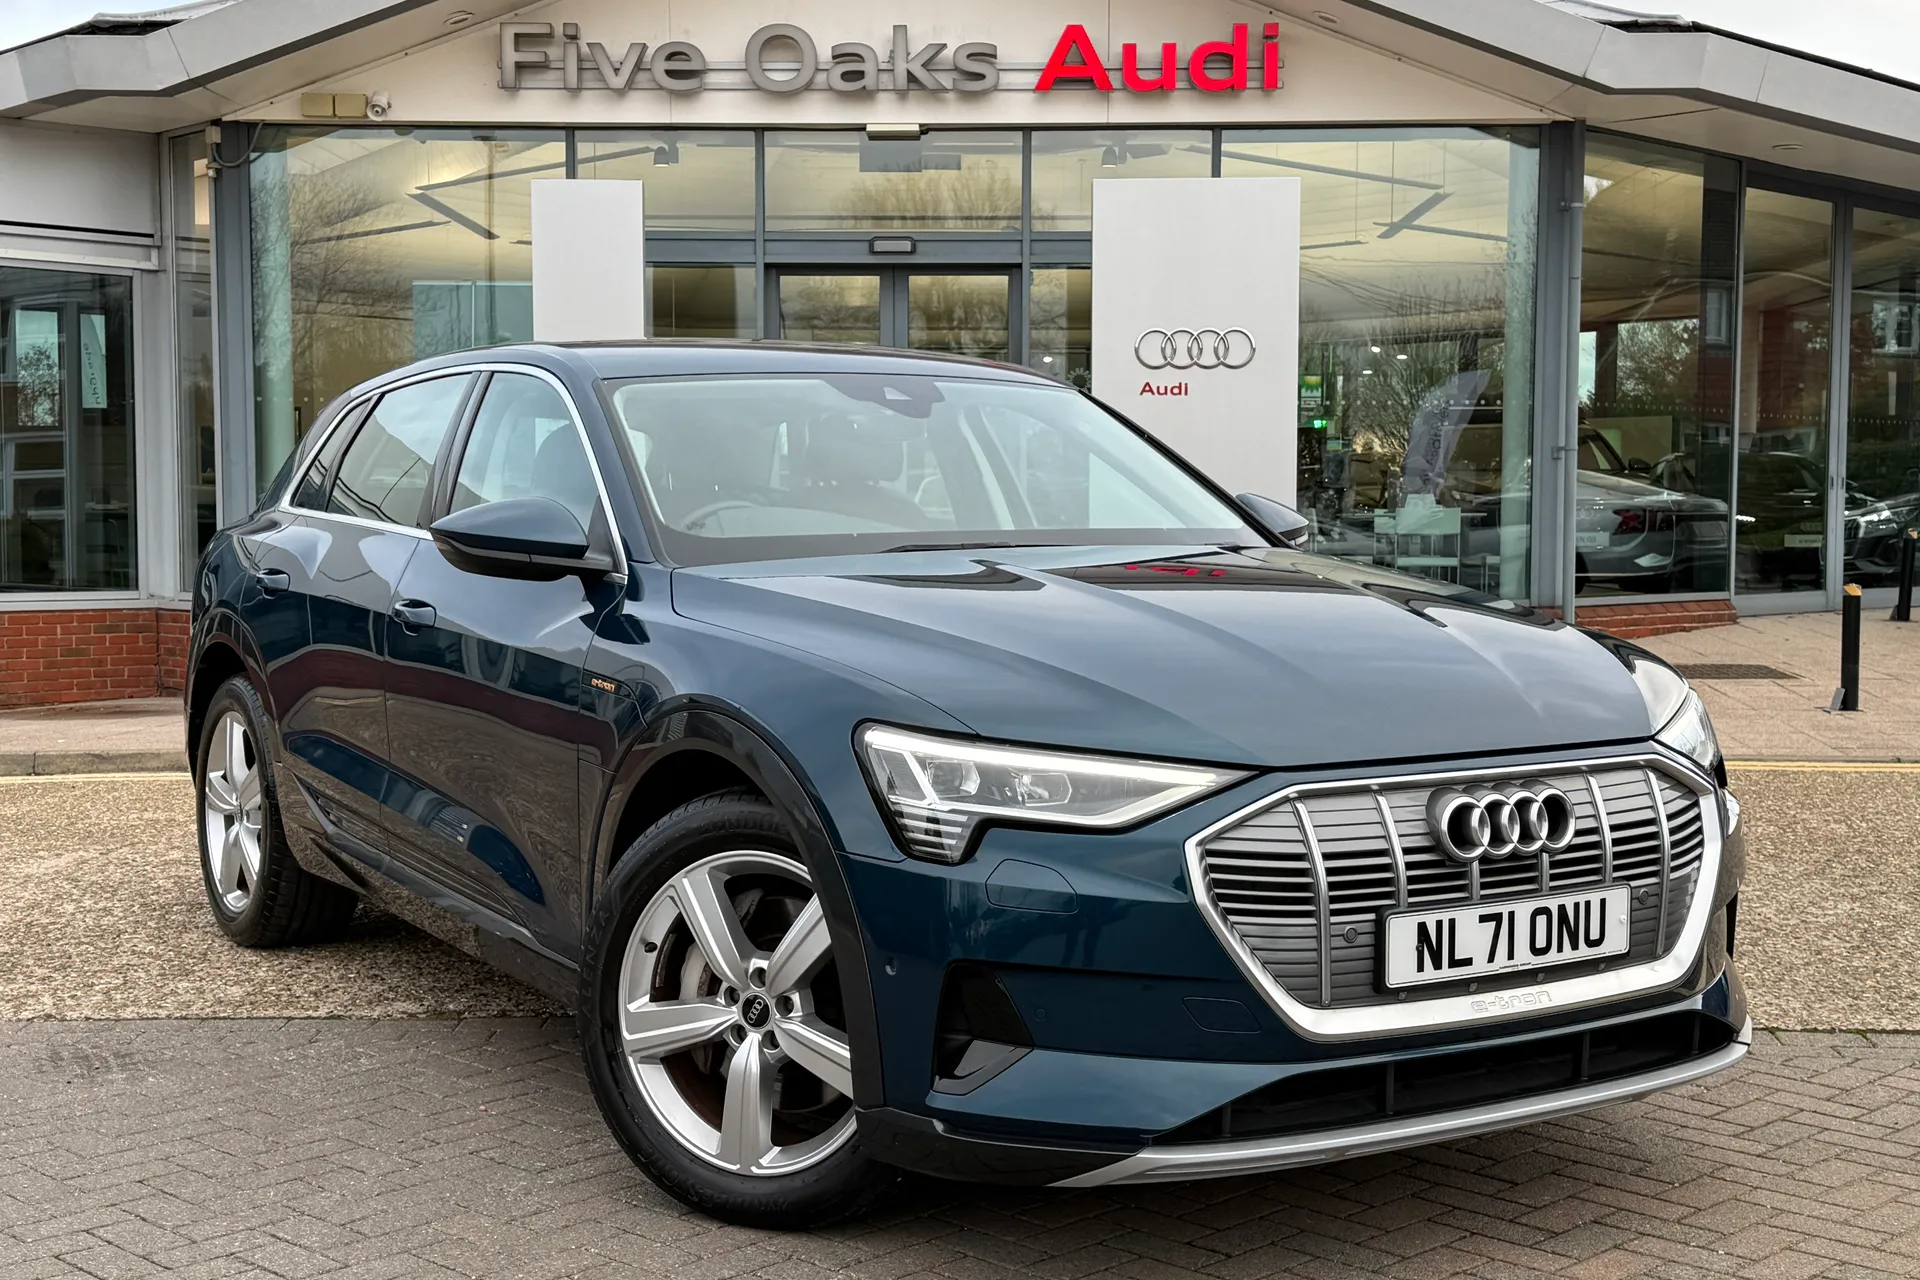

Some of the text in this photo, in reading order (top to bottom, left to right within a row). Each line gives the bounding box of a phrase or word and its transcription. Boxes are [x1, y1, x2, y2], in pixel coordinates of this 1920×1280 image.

[499, 22, 1280, 94] Five Oaks Audi
[1139, 381, 1189, 396] Audi
[1416, 898, 1607, 973] NL71 ONU
[1471, 990, 1553, 1014] e-tron
